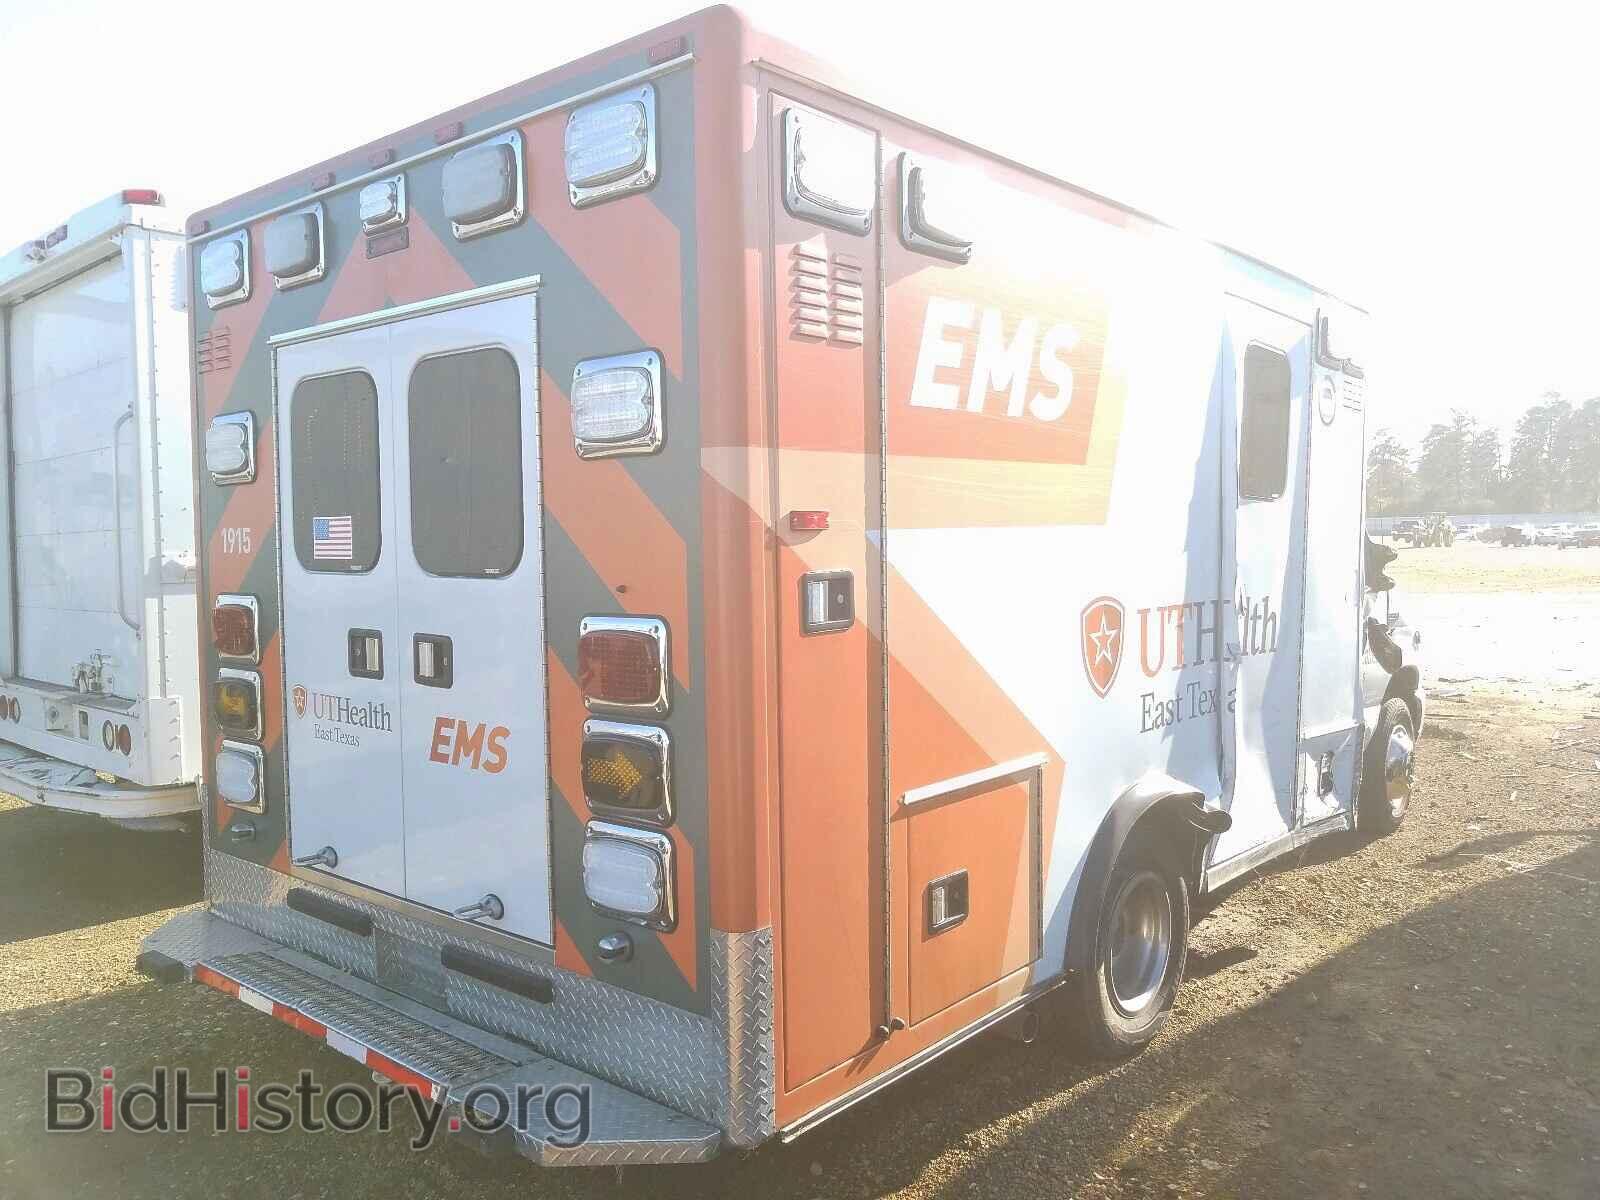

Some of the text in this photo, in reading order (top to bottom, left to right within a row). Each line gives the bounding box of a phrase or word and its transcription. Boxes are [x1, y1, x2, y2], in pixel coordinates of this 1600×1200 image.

[910, 296, 1080, 422] EMS
[222, 527, 251, 554] 1915
[312, 692, 392, 733] UTHealth
[1139, 692, 1183, 733] East
[314, 723, 360, 747] East Texas
[429, 716, 511, 774] EMS
